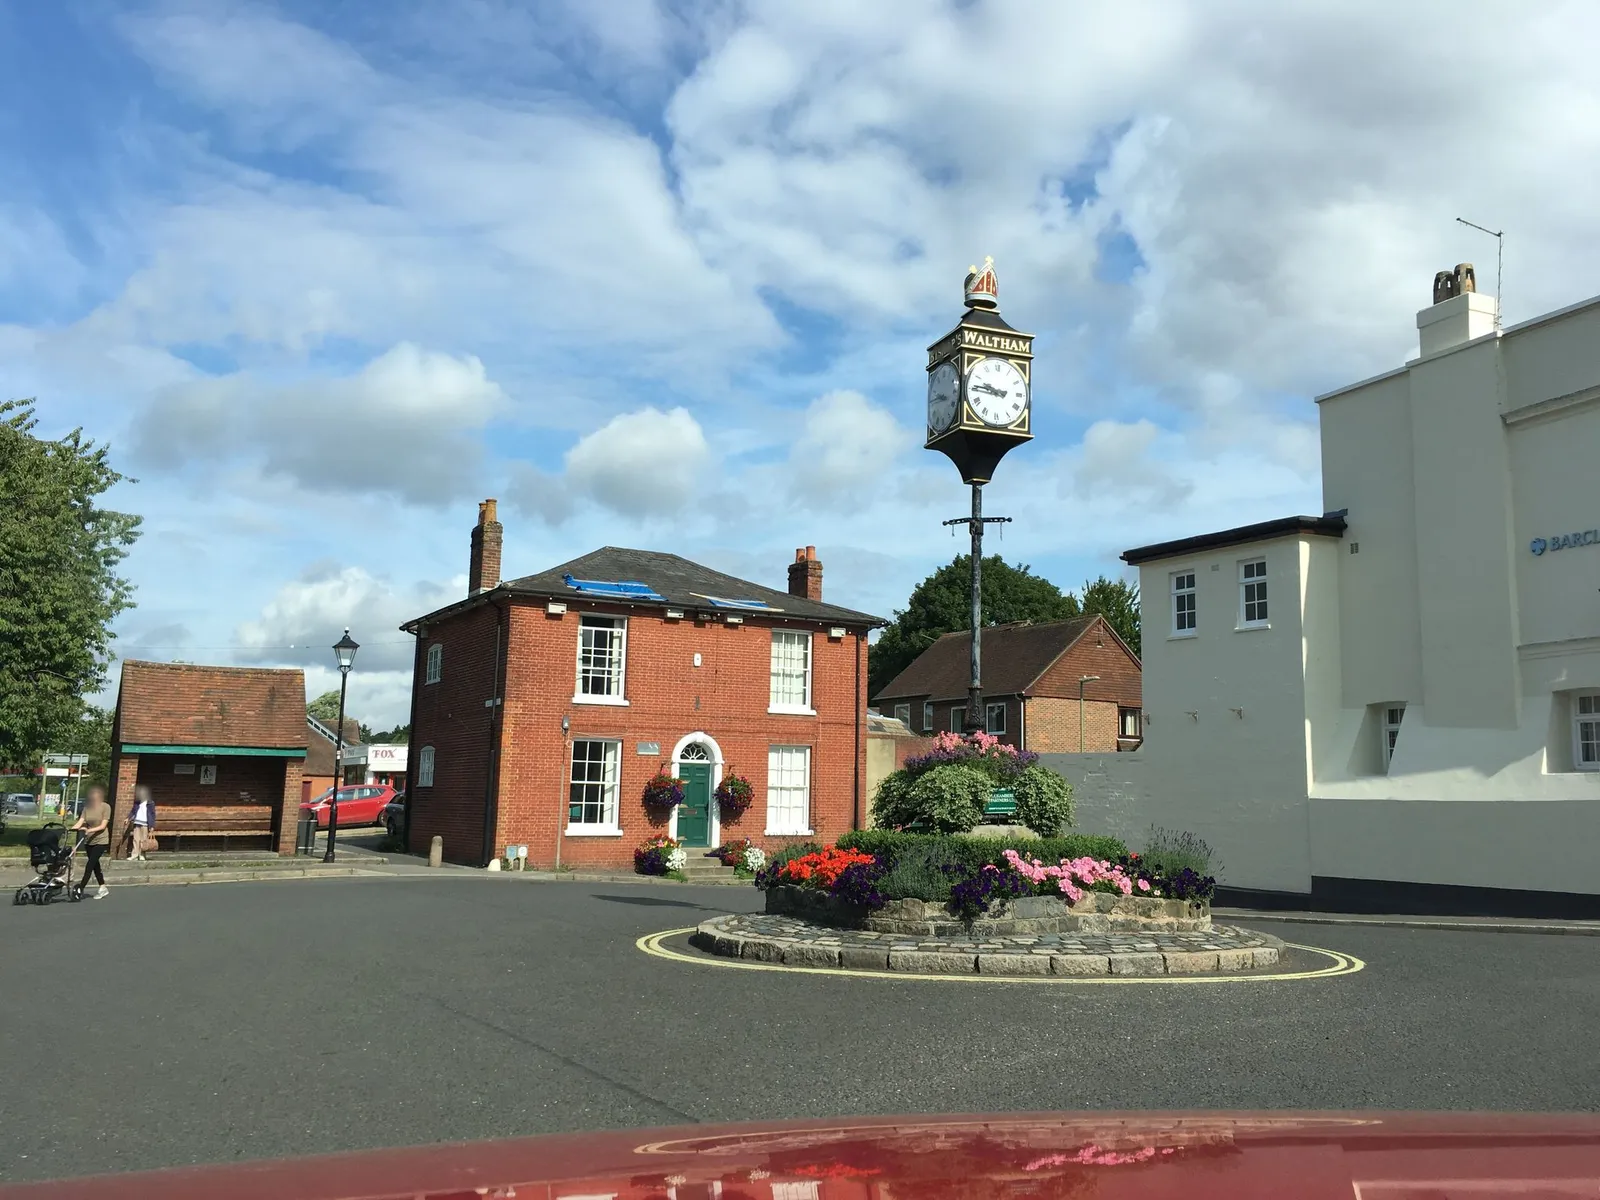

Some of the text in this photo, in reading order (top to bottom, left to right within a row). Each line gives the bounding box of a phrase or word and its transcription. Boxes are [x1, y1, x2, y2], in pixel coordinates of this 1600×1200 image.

[964, 330, 1030, 352] WALTHAM
[1550, 529, 1600, 551] BARCL
[372, 749, 396, 758] FOX
